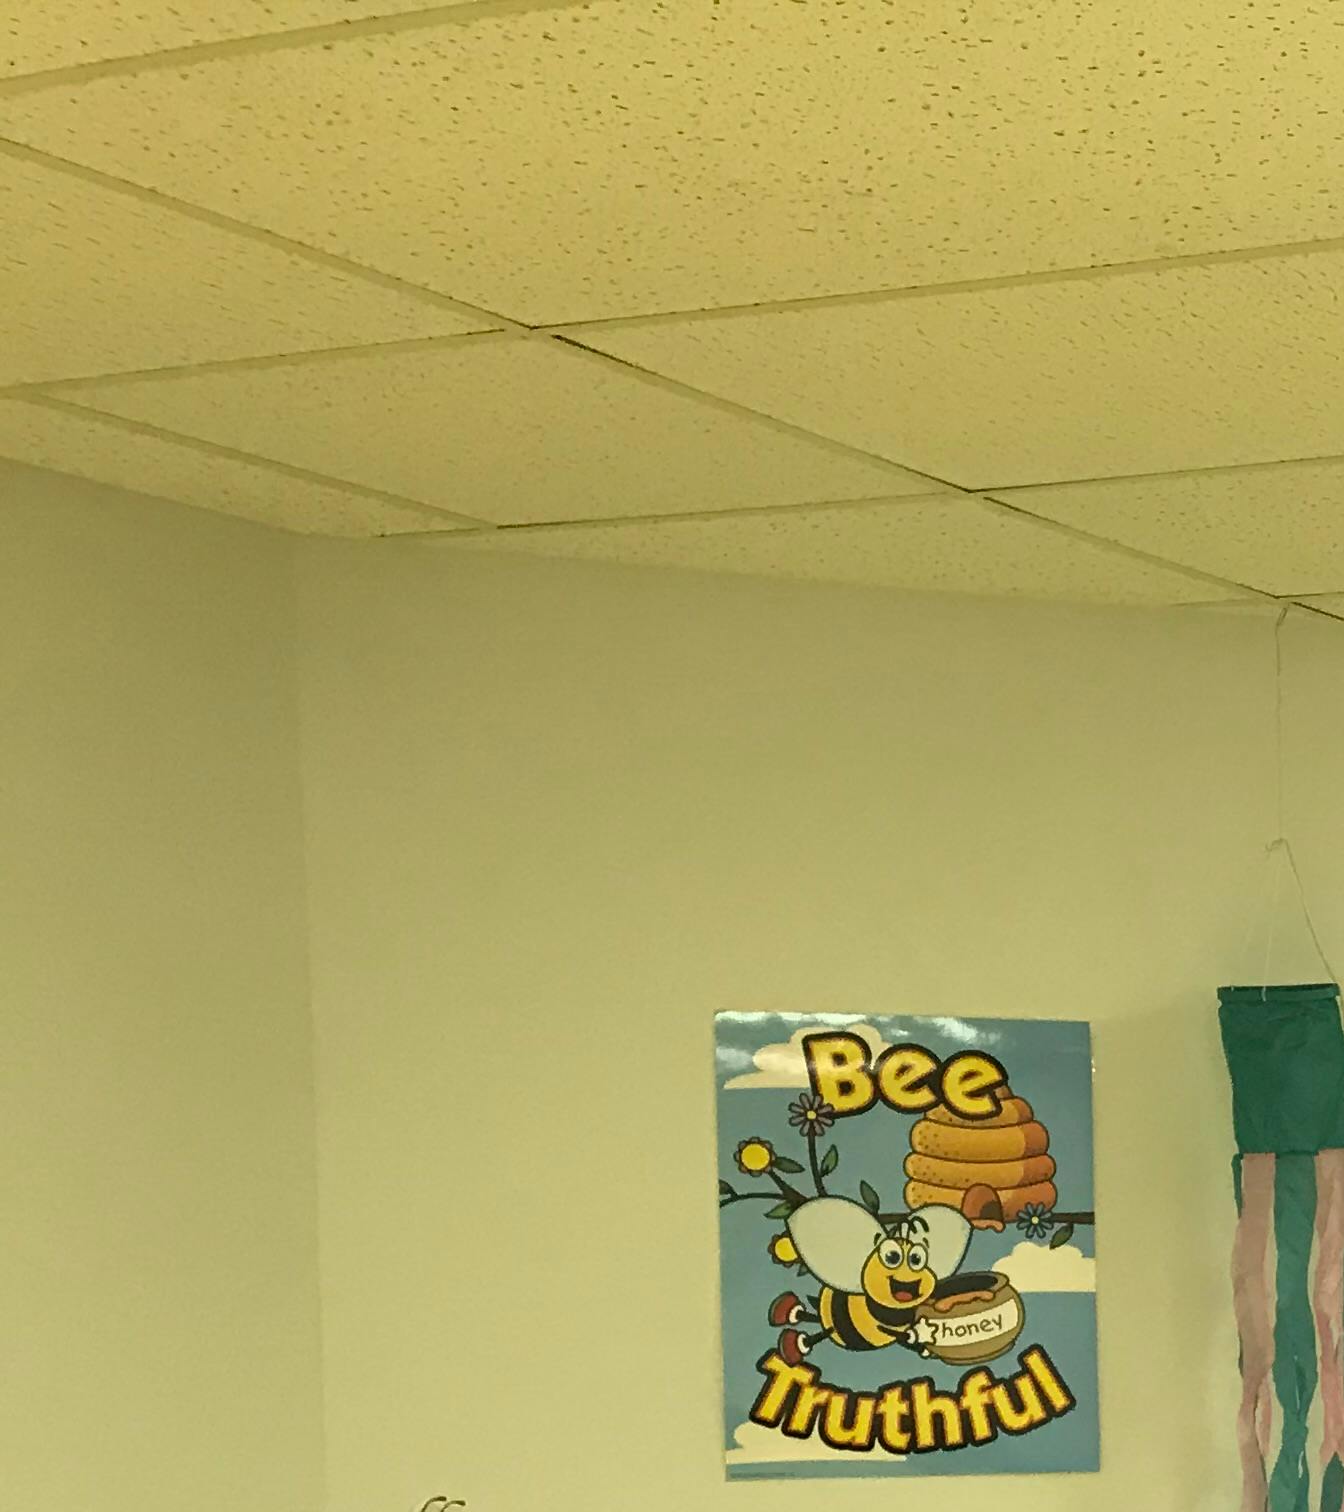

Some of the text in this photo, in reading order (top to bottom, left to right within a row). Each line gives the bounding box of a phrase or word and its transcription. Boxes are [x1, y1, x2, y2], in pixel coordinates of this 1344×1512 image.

[801, 1031, 1010, 1120] Bee
[941, 1313, 1002, 1338] honey
[749, 1344, 1077, 1455] Truthful
